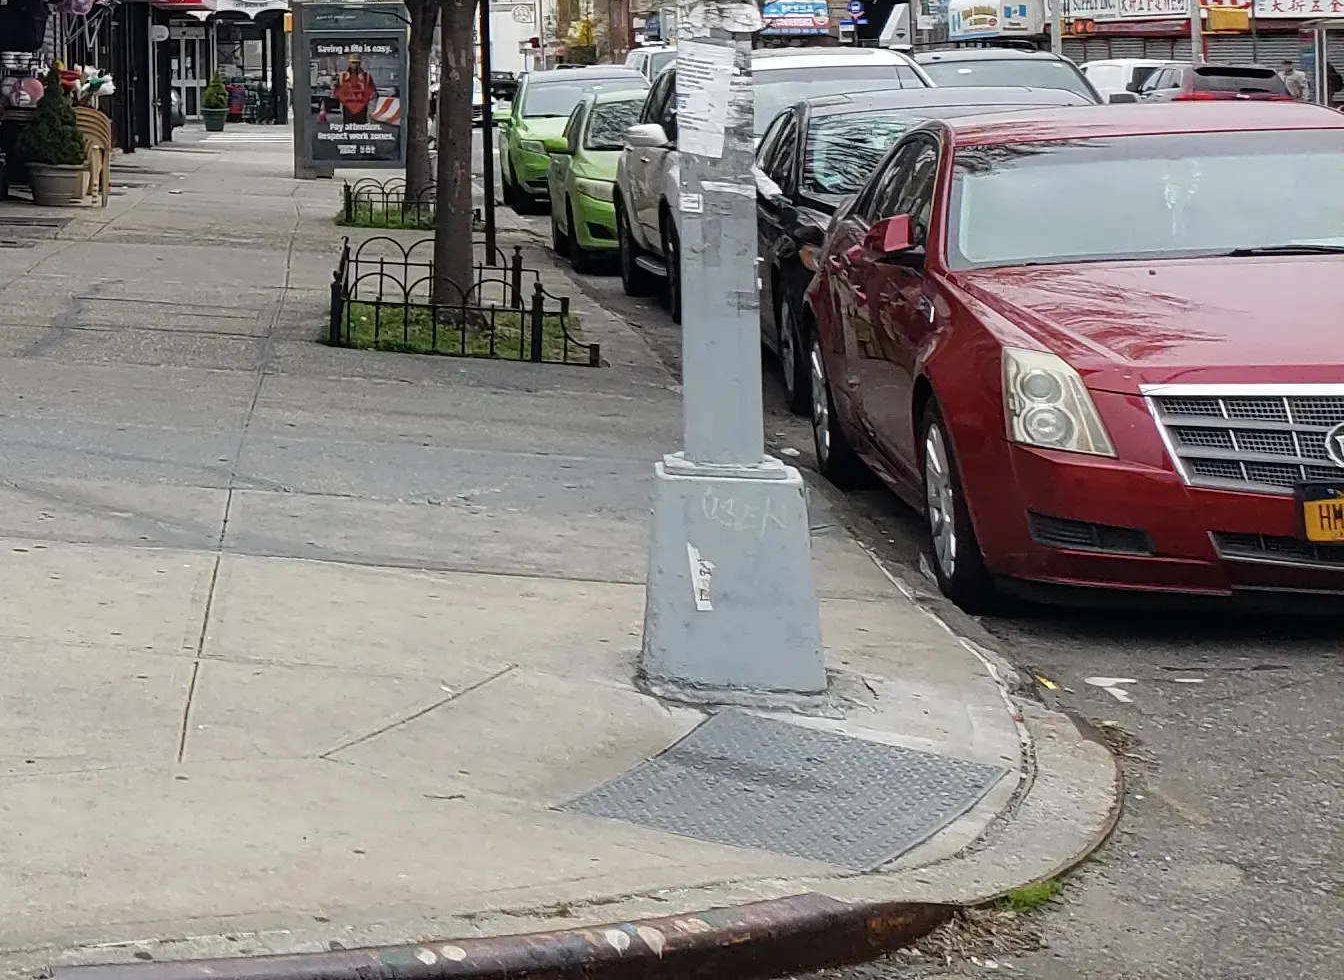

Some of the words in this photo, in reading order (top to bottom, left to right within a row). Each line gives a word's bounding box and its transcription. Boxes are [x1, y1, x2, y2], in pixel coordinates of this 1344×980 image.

[317, 44, 343, 55] Saving
[350, 43, 363, 53] life
[364, 43, 371, 53] is
[330, 123, 344, 132] Pay
[317, 132, 348, 141] Respect
[349, 132, 369, 140] work
